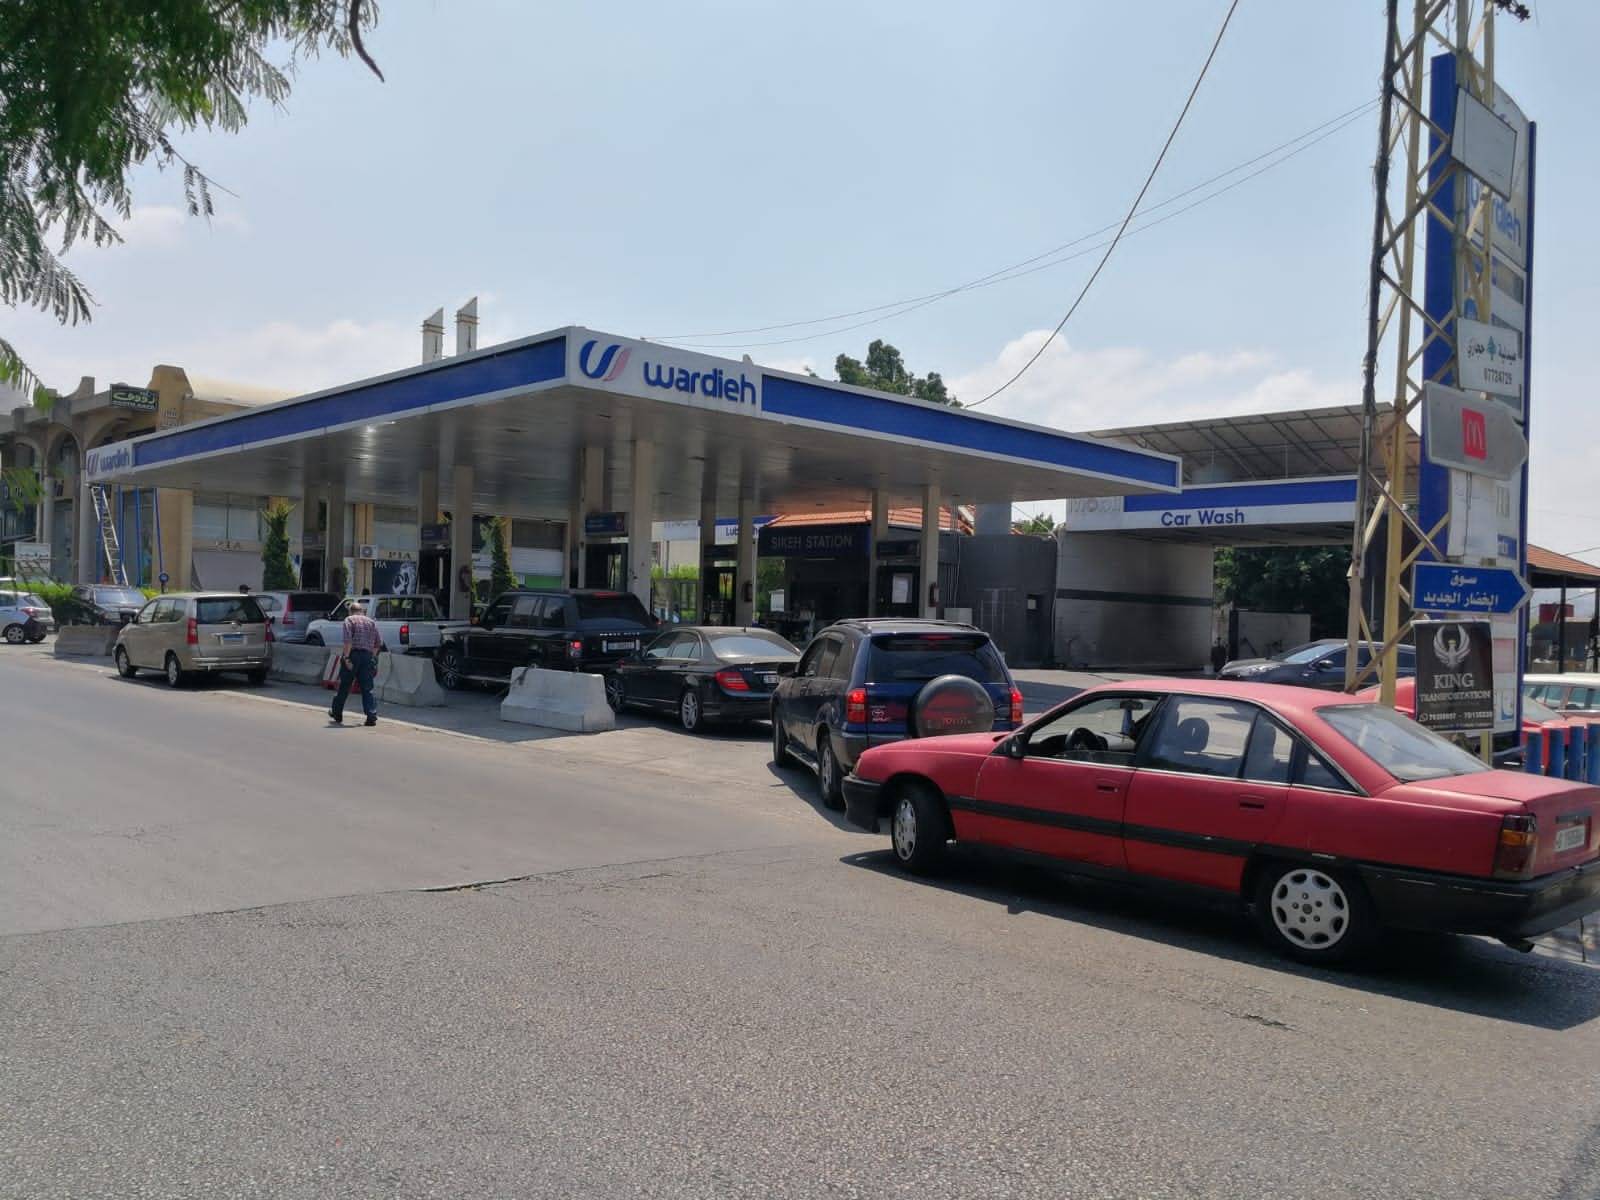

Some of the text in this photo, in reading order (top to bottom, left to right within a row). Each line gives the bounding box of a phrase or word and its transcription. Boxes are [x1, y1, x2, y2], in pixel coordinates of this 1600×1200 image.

[643, 361, 756, 405] wardieh
[1160, 507, 1245, 527] Car Wash
[805, 535, 853, 549] STATION
[1450, 569, 1478, 587] سوق
[1432, 672, 1475, 689] KING
